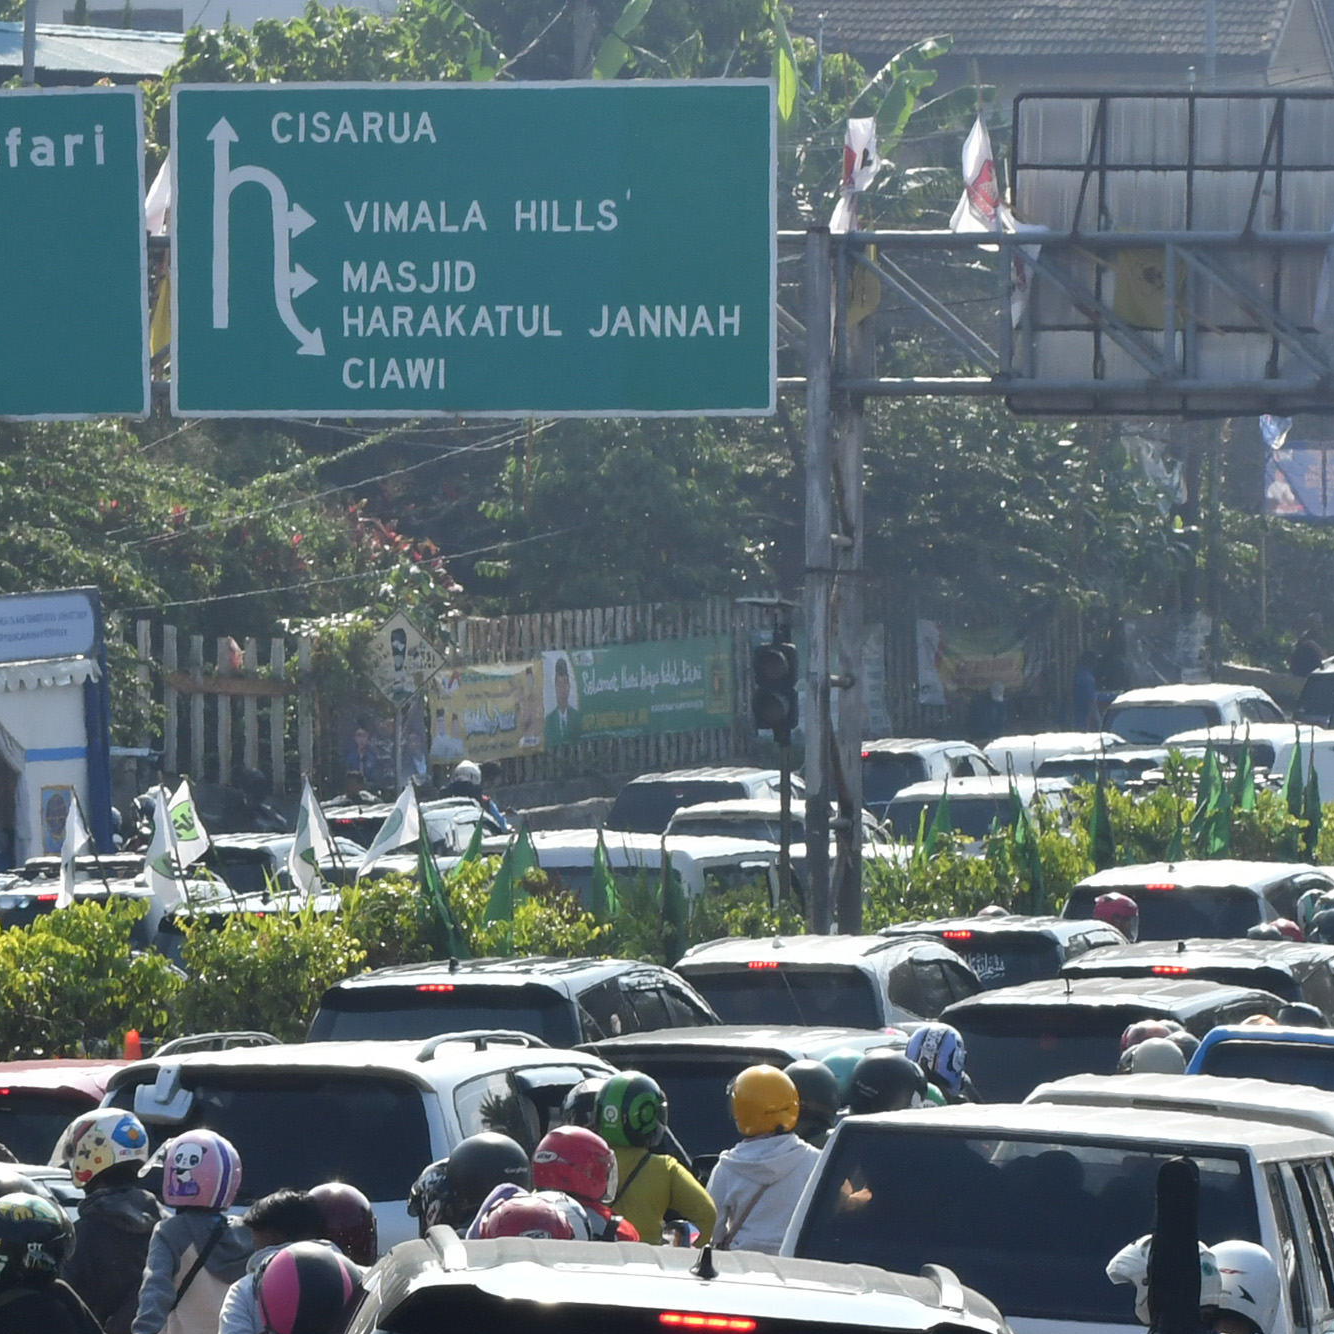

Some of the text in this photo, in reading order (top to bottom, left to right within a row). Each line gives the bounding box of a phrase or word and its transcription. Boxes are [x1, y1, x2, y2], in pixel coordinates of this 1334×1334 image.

[271, 111, 438, 144] CISARUA
[344, 198, 618, 235] VIMALA HILLS
[342, 261, 477, 293] MASJID
[342, 305, 742, 338] HARAKATUL JANNAH
[342, 358, 447, 391] CIAWI
